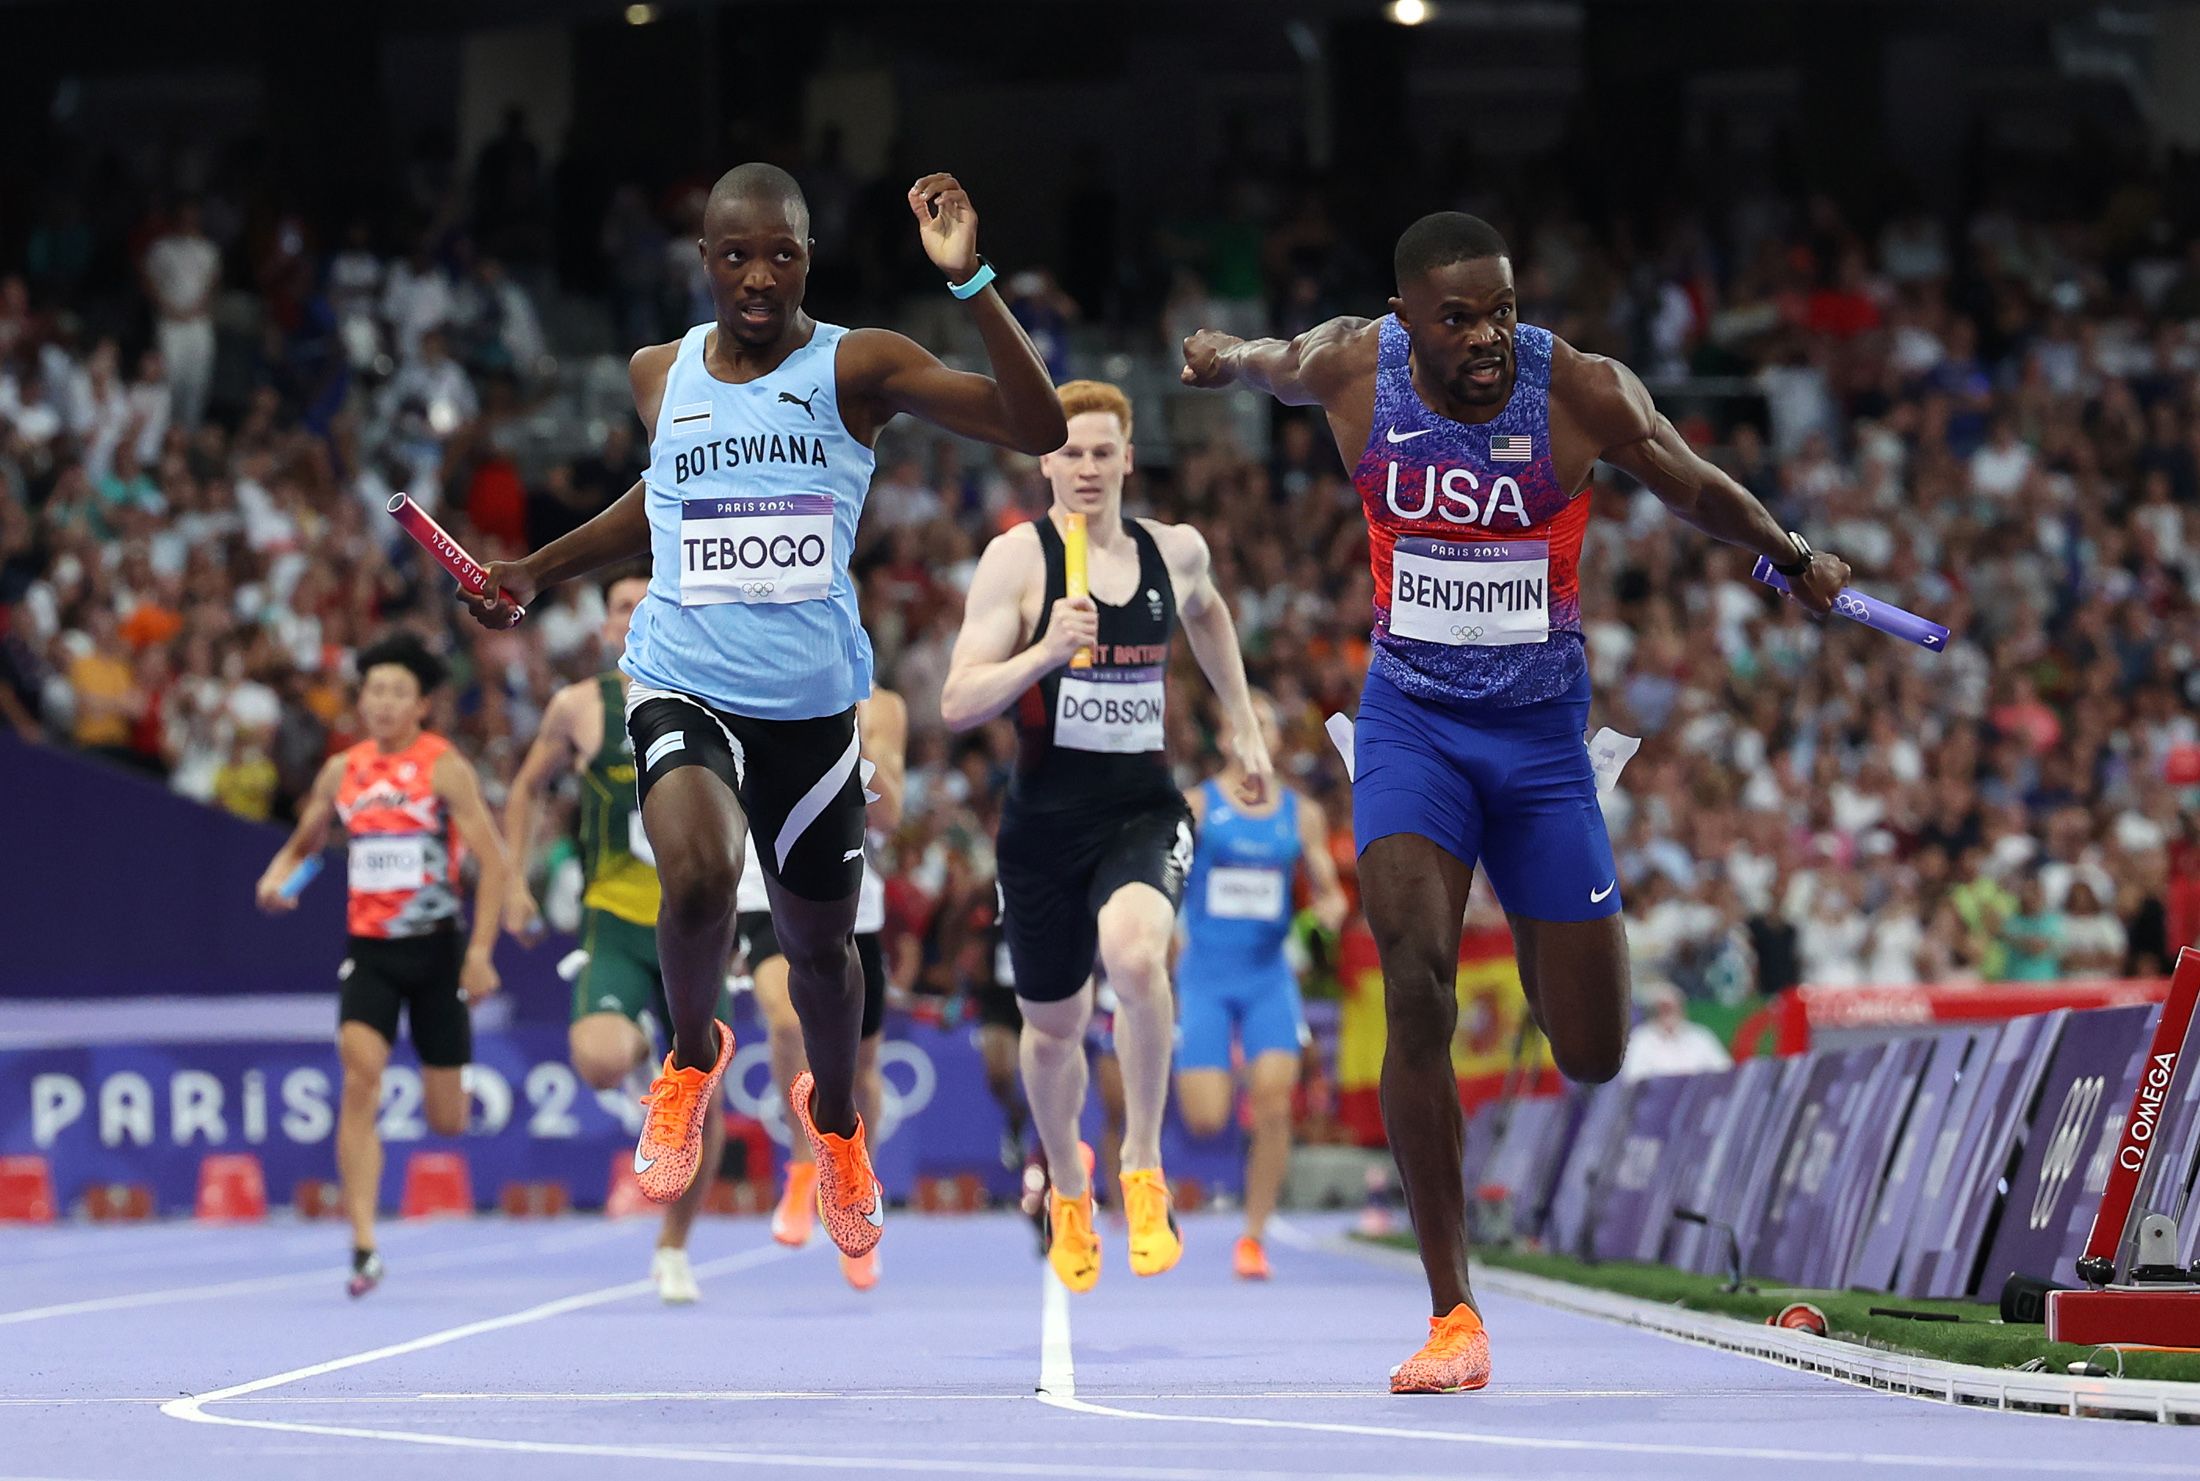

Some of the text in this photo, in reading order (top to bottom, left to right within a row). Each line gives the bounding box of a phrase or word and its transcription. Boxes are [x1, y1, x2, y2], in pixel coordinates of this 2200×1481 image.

[675, 434, 828, 484] BOTSWANA
[717, 501, 794, 513] PARIS 2024
[1386, 461, 1532, 527] USA
[683, 534, 825, 572] TEBOGO
[1430, 544, 1509, 557] PARIS 2024
[1398, 570, 1543, 613] BENJAMIN
[1062, 696, 1161, 724] DOBSON
[31, 1069, 333, 1146] PARIS
[2131, 1051, 2176, 1141] OMEGA
